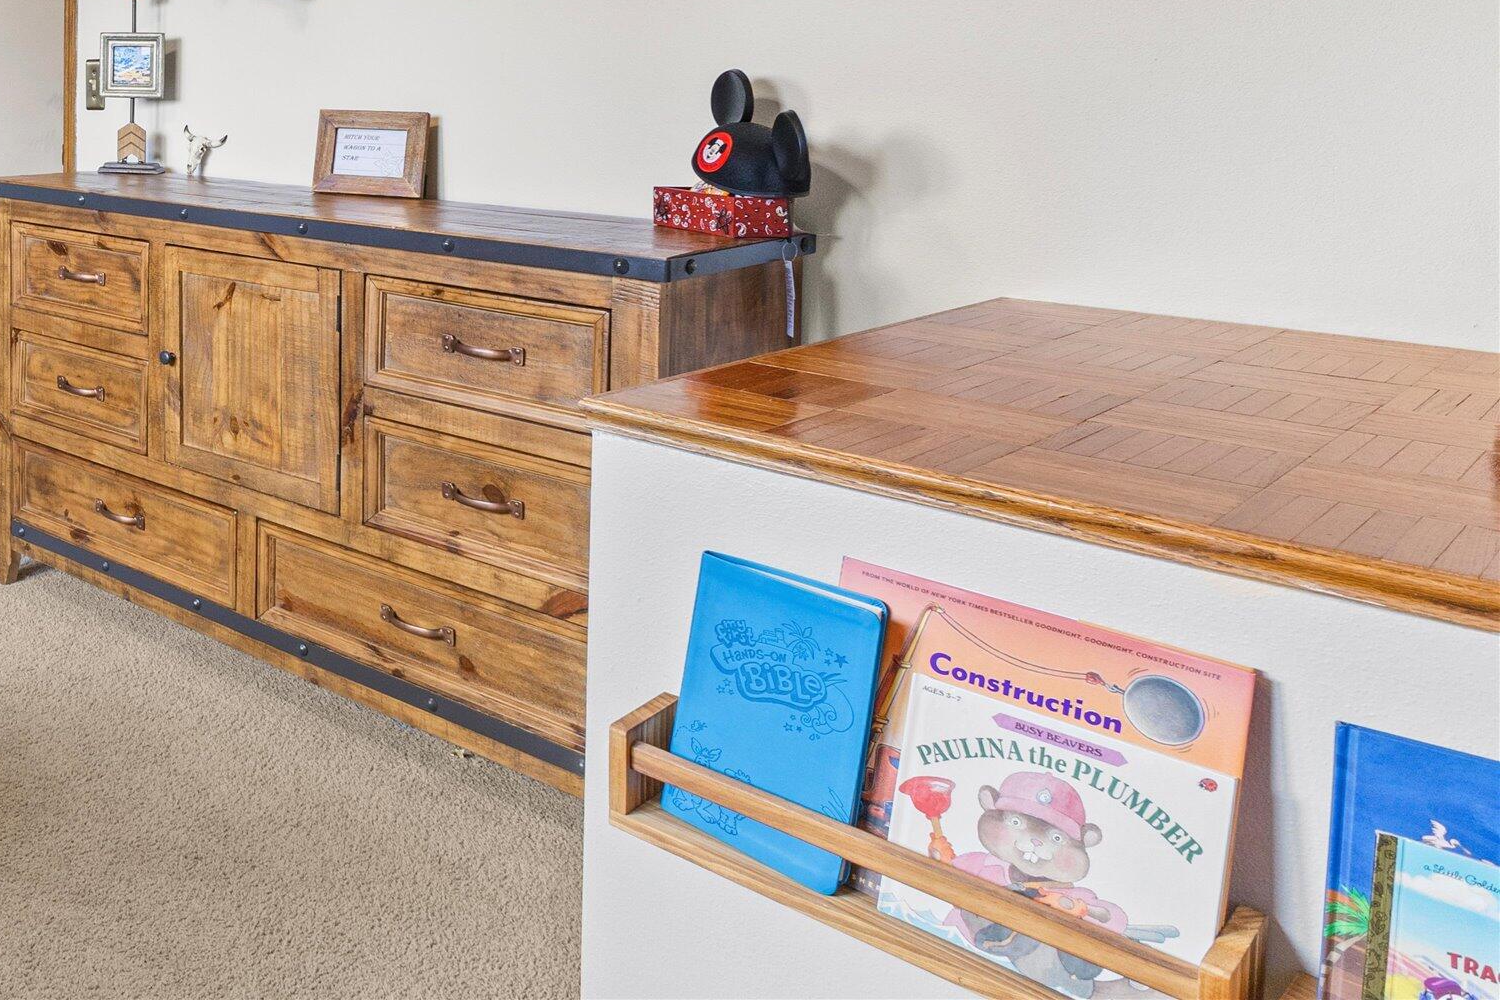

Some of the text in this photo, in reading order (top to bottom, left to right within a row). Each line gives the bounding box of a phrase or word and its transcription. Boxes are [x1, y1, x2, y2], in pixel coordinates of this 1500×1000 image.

[861, 569, 881, 581] FROM
[881, 576, 895, 586] THE
[895, 580, 920, 592] WORLD
[930, 591, 948, 601] NEW
[947, 597, 967, 607] YORK
[968, 602, 990, 613] TIMES
[989, 608, 1034, 626] BESTSELLER
[1135, 651, 1203, 676] CONSTRUCTION
[1202, 669, 1223, 682] SITE
[922, 685, 945, 697] AGES
[928, 651, 1123, 735] Construction
[1014, 721, 1103, 758] BUSY BEAVERS
[915, 735, 1205, 866] PAULINA the PLUMBER
[1432, 863, 1464, 881] Little
